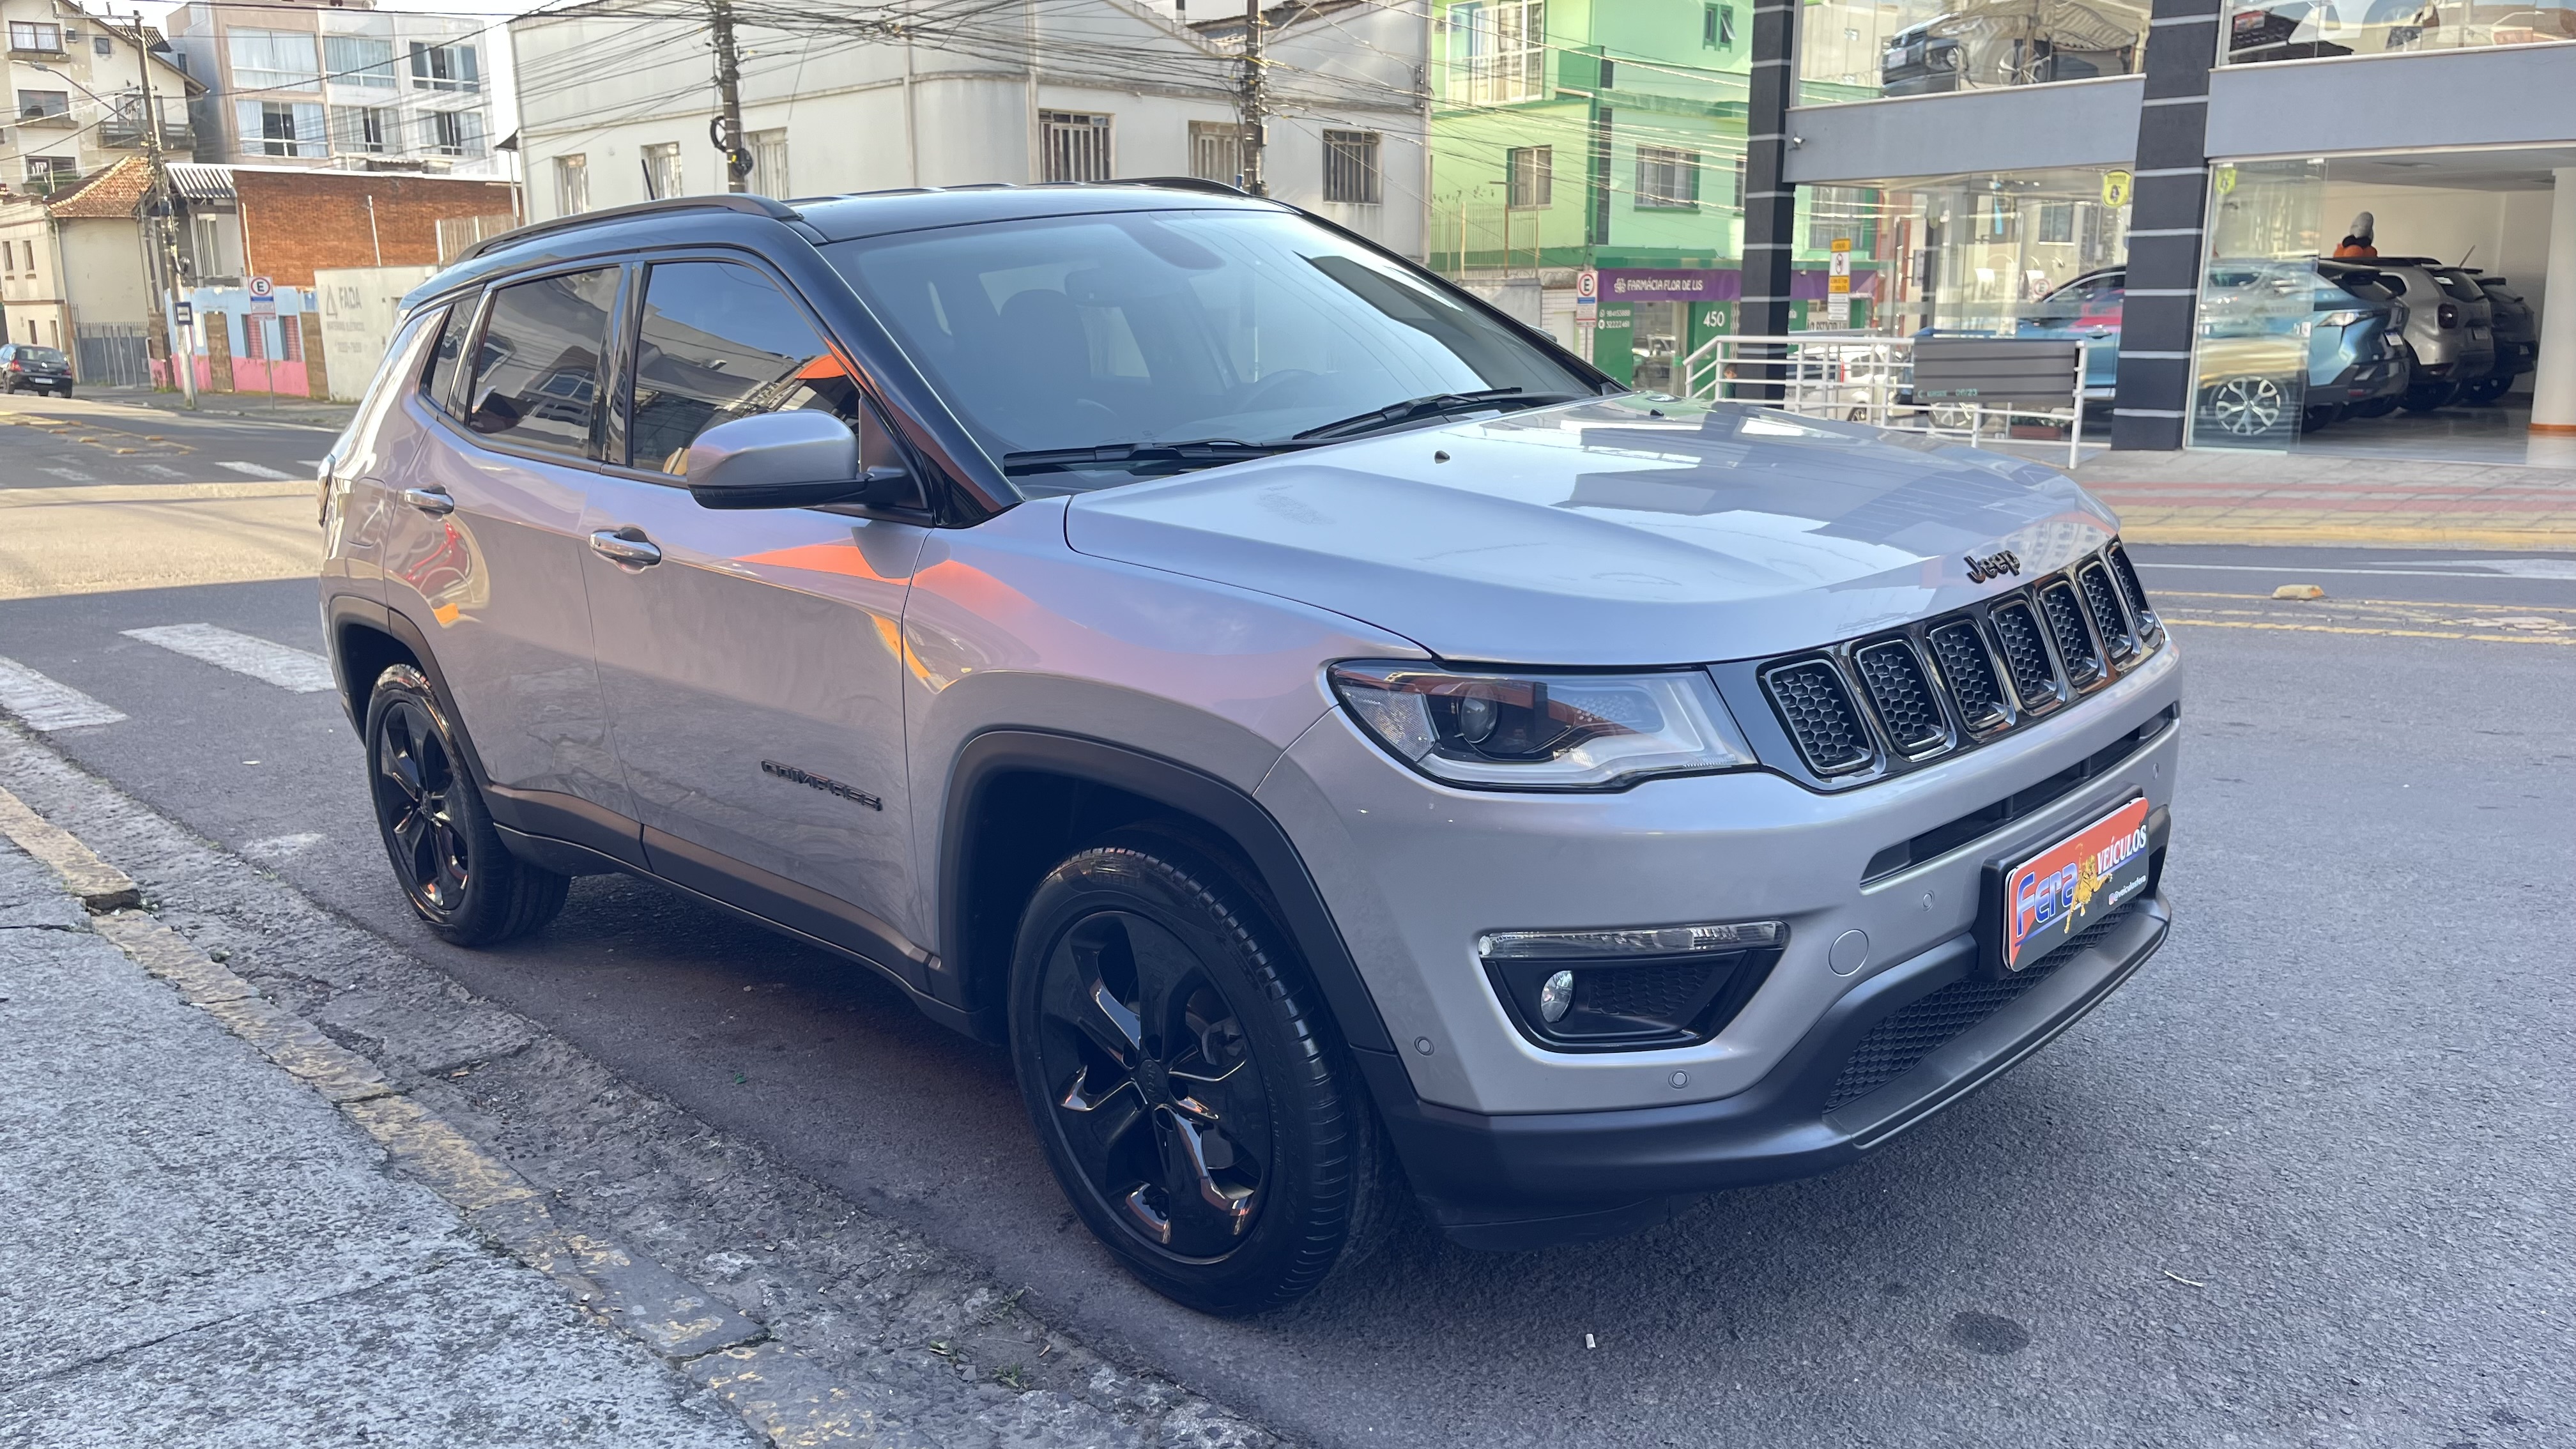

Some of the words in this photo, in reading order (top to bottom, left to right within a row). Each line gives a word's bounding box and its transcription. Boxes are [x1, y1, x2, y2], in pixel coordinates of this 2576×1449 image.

[257, 281, 264, 292] E
[1584, 279, 1590, 291] E
[1627, 276, 1662, 291] FARMÁCIA
[1663, 279, 1681, 291] FLOR
[1682, 279, 1691, 291] DE
[1692, 279, 1703, 291] LIS
[338, 286, 362, 309] FADA
[1703, 310, 1725, 328] 450
[1963, 550, 2020, 584] Jeep
[761, 759, 883, 811] COMPASS
[2017, 862, 2078, 938] Fera
[2097, 824, 2146, 875] VEÍCULOS
